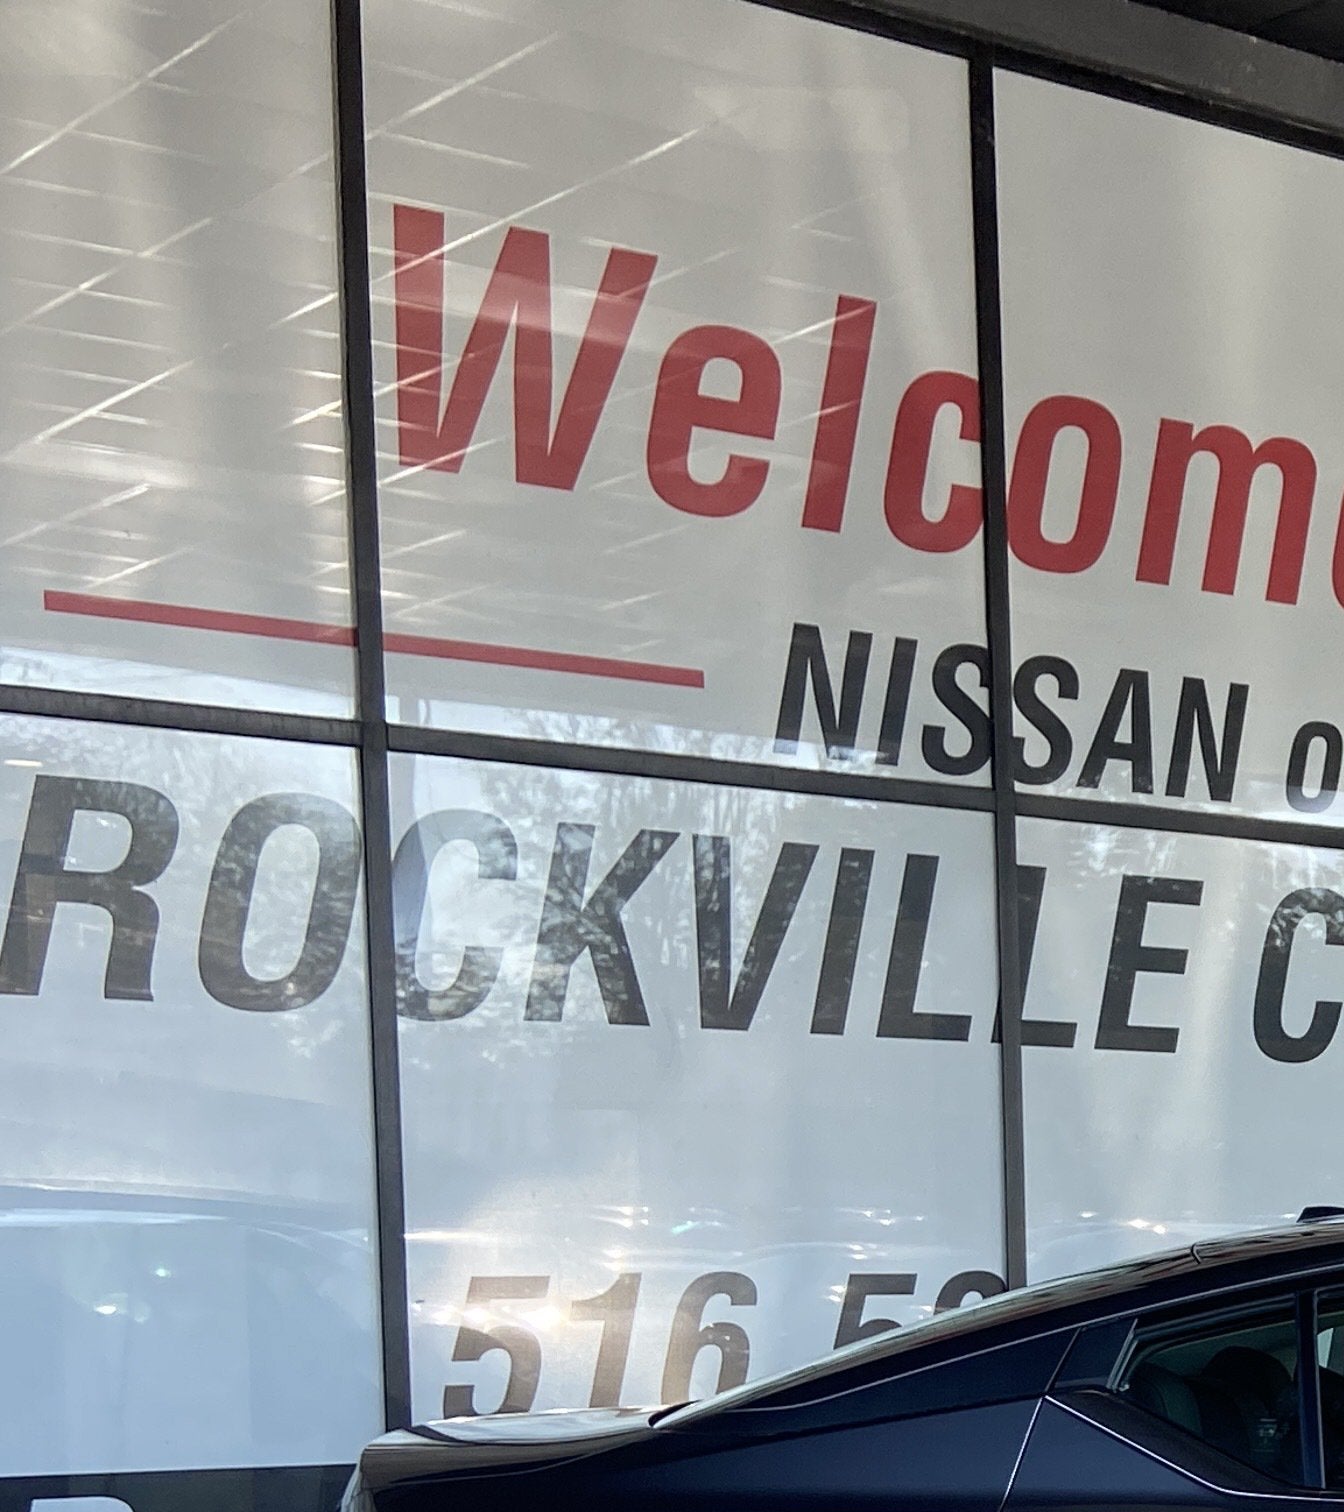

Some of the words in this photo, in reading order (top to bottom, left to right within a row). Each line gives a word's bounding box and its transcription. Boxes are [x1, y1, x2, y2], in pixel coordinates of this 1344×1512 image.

[773, 622, 1250, 803] NISSAN
[0, 774, 1205, 1054] ROCKVILLE
[442, 1270, 758, 1420] 516
